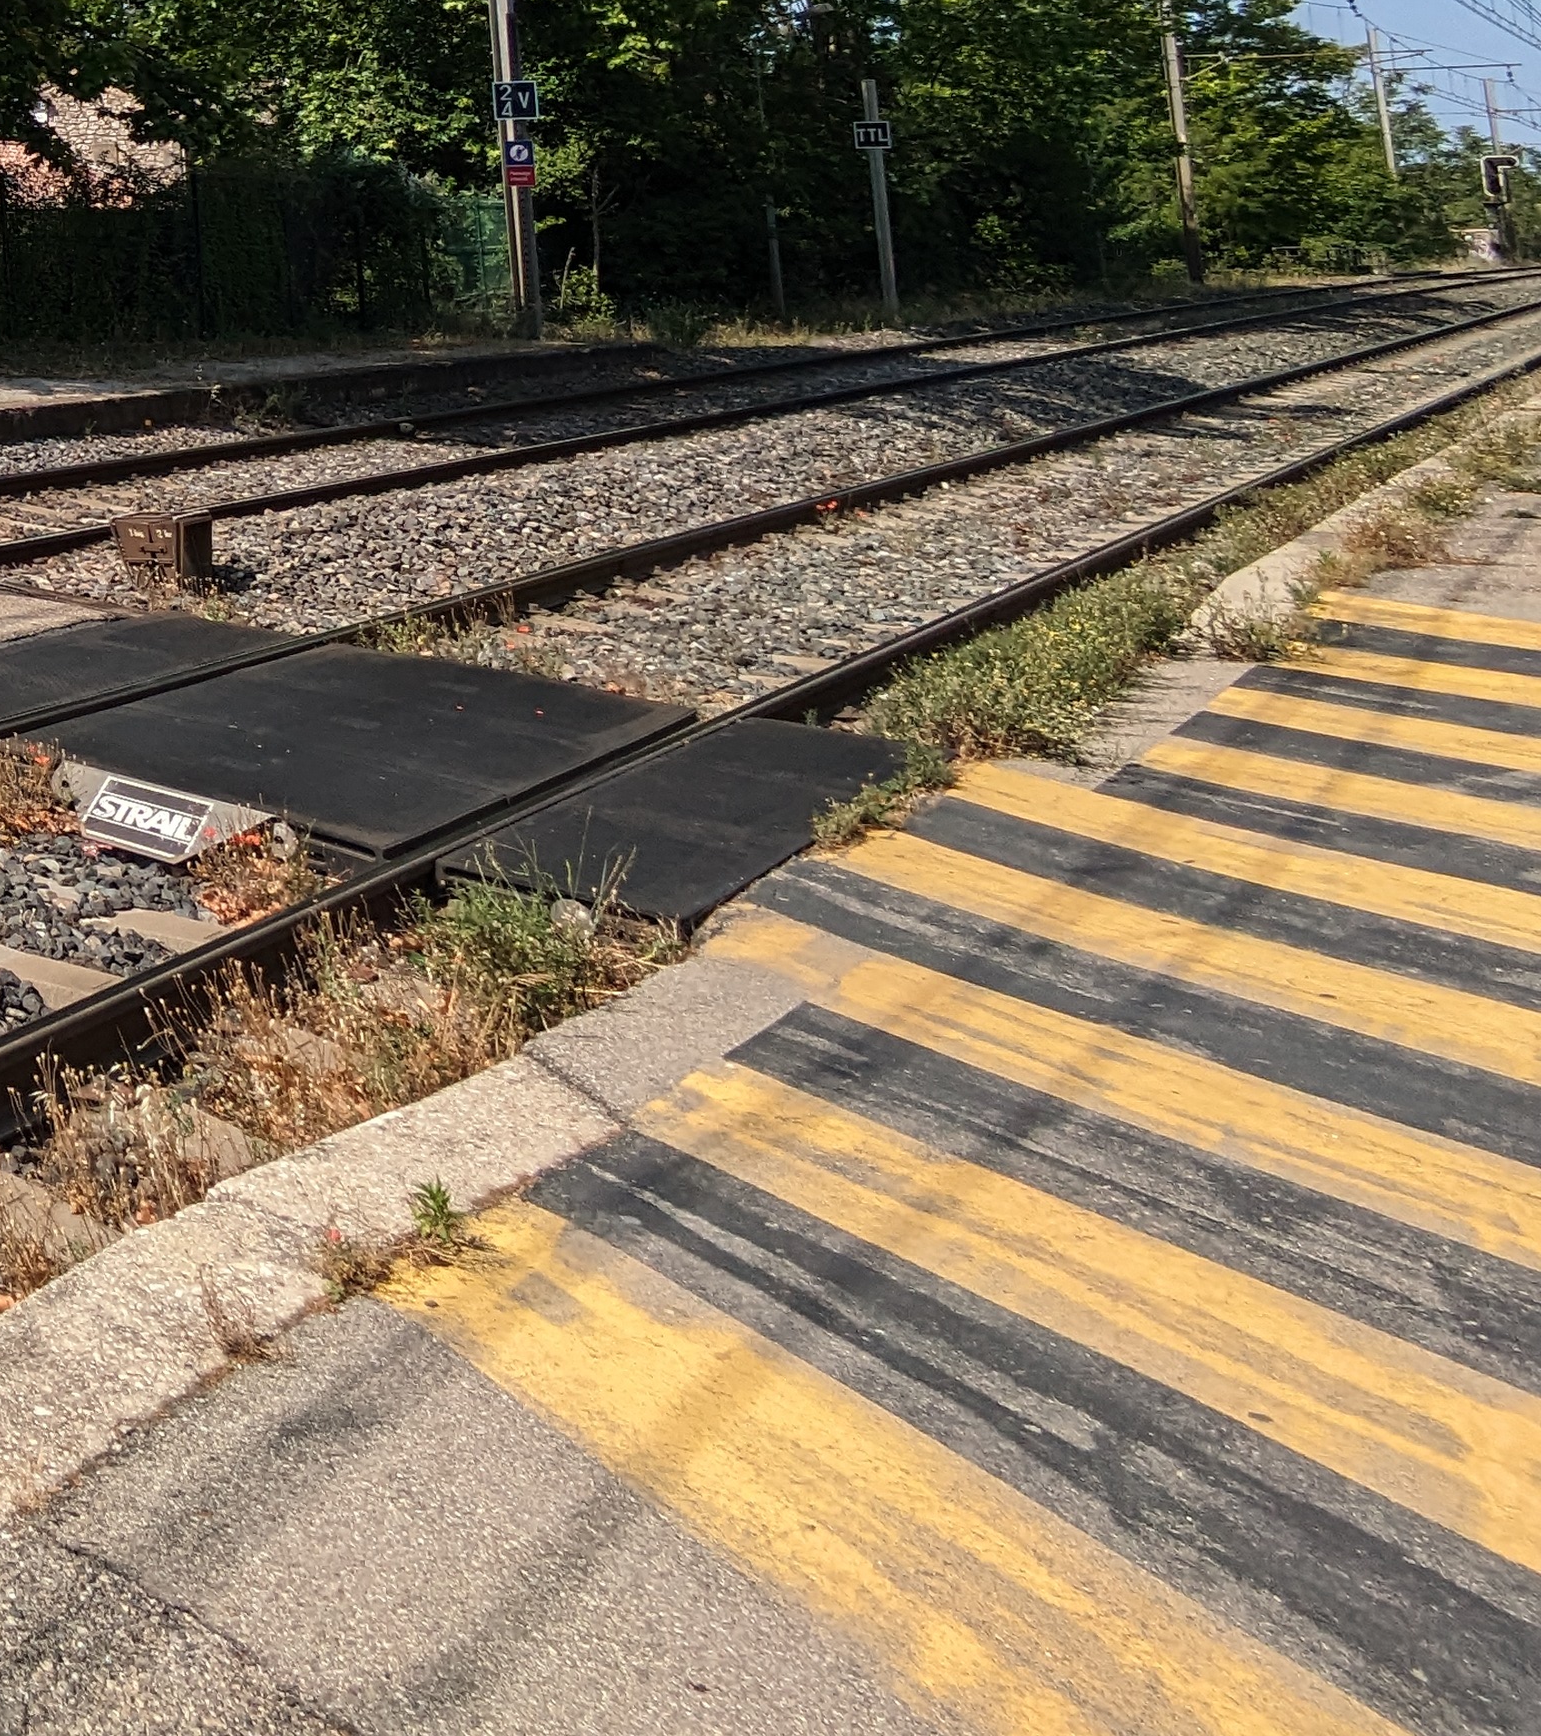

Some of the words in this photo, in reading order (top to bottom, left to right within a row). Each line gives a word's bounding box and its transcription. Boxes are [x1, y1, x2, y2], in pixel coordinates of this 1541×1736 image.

[499, 84, 512, 101] 2
[518, 91, 530, 109] V
[501, 101, 513, 117] 4
[856, 128, 888, 142] TTL
[92, 795, 195, 842] STRAIL
